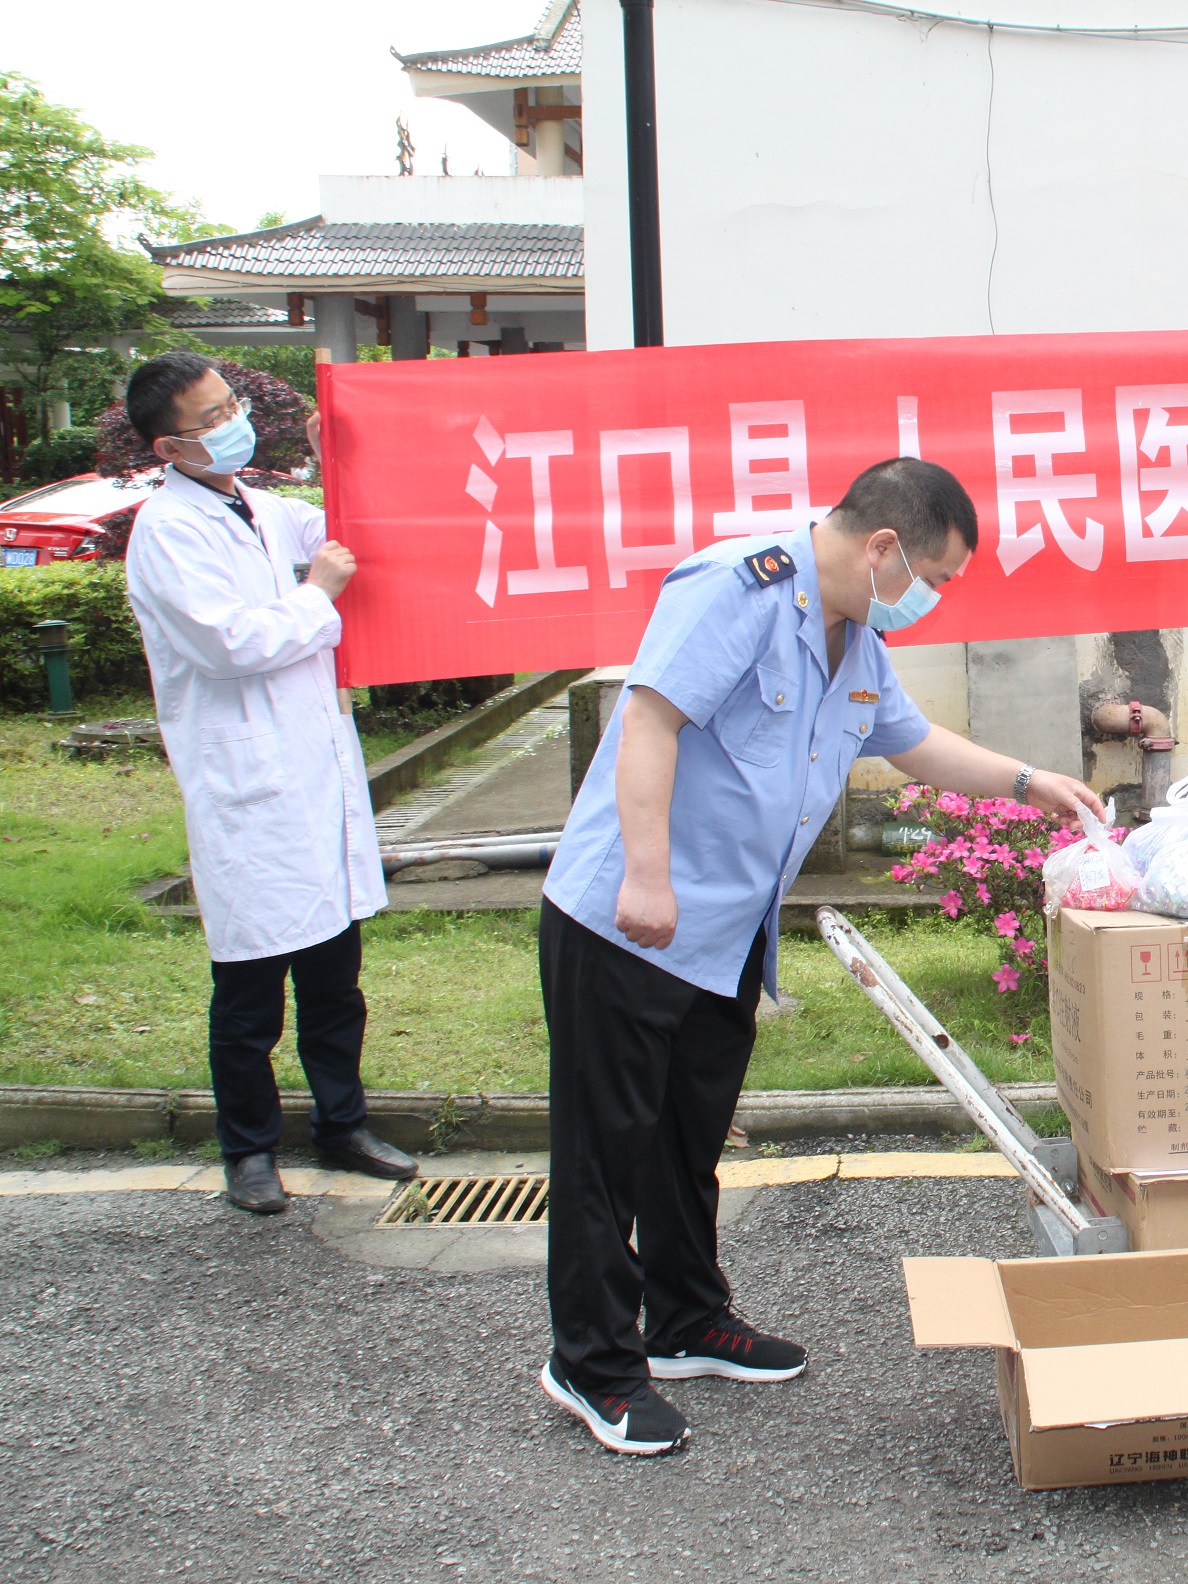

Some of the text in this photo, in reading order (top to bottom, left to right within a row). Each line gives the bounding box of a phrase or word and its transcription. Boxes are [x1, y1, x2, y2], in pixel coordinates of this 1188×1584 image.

[1135, 1069, 1179, 1081] 产品批号:
[1137, 1089, 1180, 1100] 生产日期:
[1138, 1109, 1181, 1120] 有效期至:
